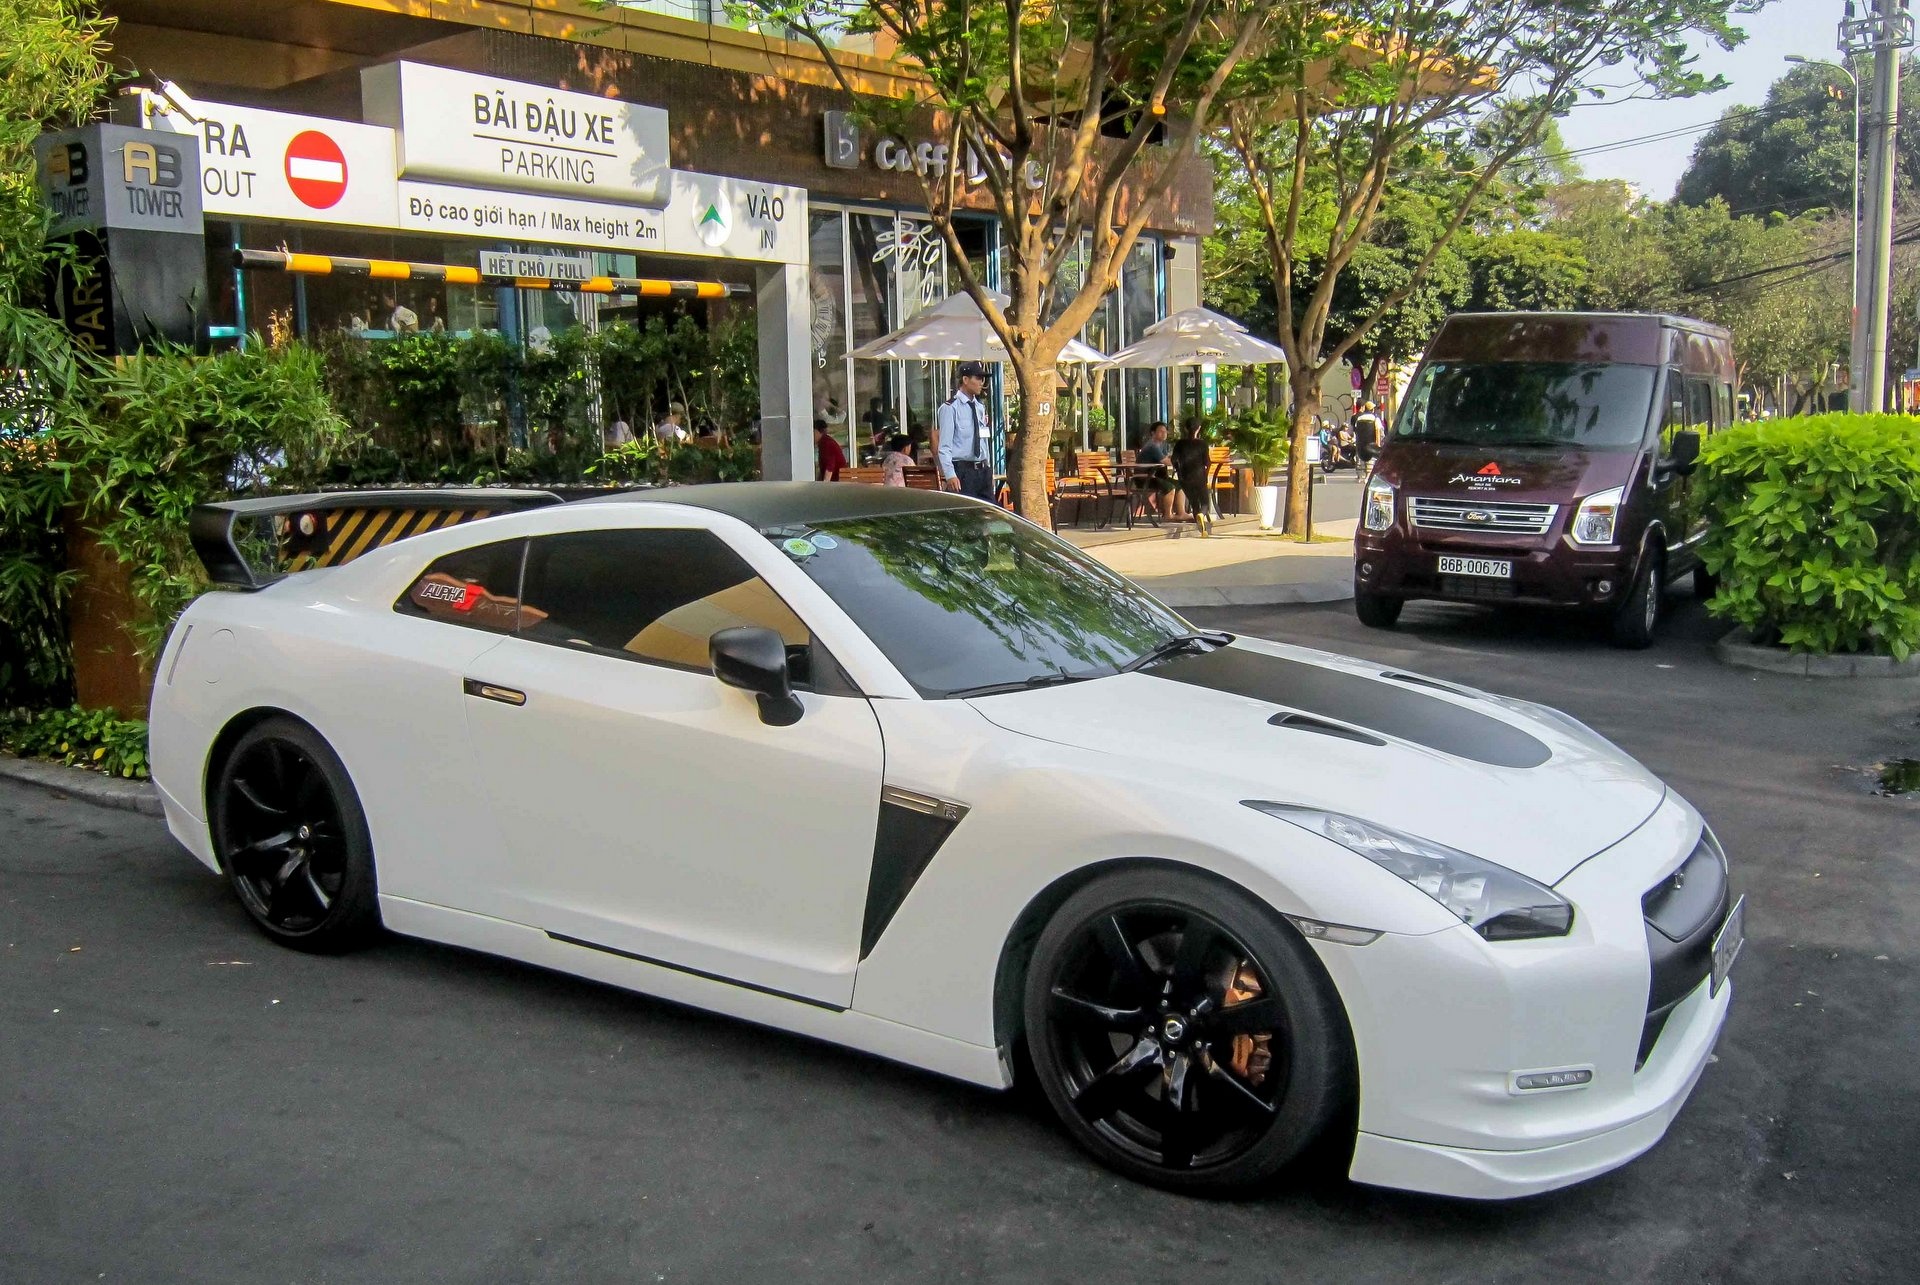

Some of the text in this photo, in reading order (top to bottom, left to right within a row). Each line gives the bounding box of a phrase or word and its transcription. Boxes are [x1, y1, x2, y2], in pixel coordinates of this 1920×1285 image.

[474, 90, 615, 144] BÃI ĐẬU XE
[205, 120, 251, 158] RA
[123, 141, 183, 188] AB
[501, 148, 595, 184] PARKING
[876, 140, 960, 178] Caff
[204, 167, 256, 198] OUT
[126, 186, 183, 218] TOWER
[410, 197, 433, 221] Độ
[439, 203, 469, 220] cao
[474, 205, 503, 227] giới
[508, 208, 537, 231] hạn
[551, 213, 581, 232] Max
[585, 217, 629, 239] height
[635, 219, 657, 239] 2m
[747, 188, 784, 222] VÀO
[761, 229, 774, 249] IN
[489, 254, 513, 275] HẾT
[557, 262, 586, 279] FULL
[1037, 402, 1051, 416] 19
[1448, 474, 1521, 485] Anantara
[1467, 512, 1487, 521] Ford
[421, 583, 466, 603] ALPHA
